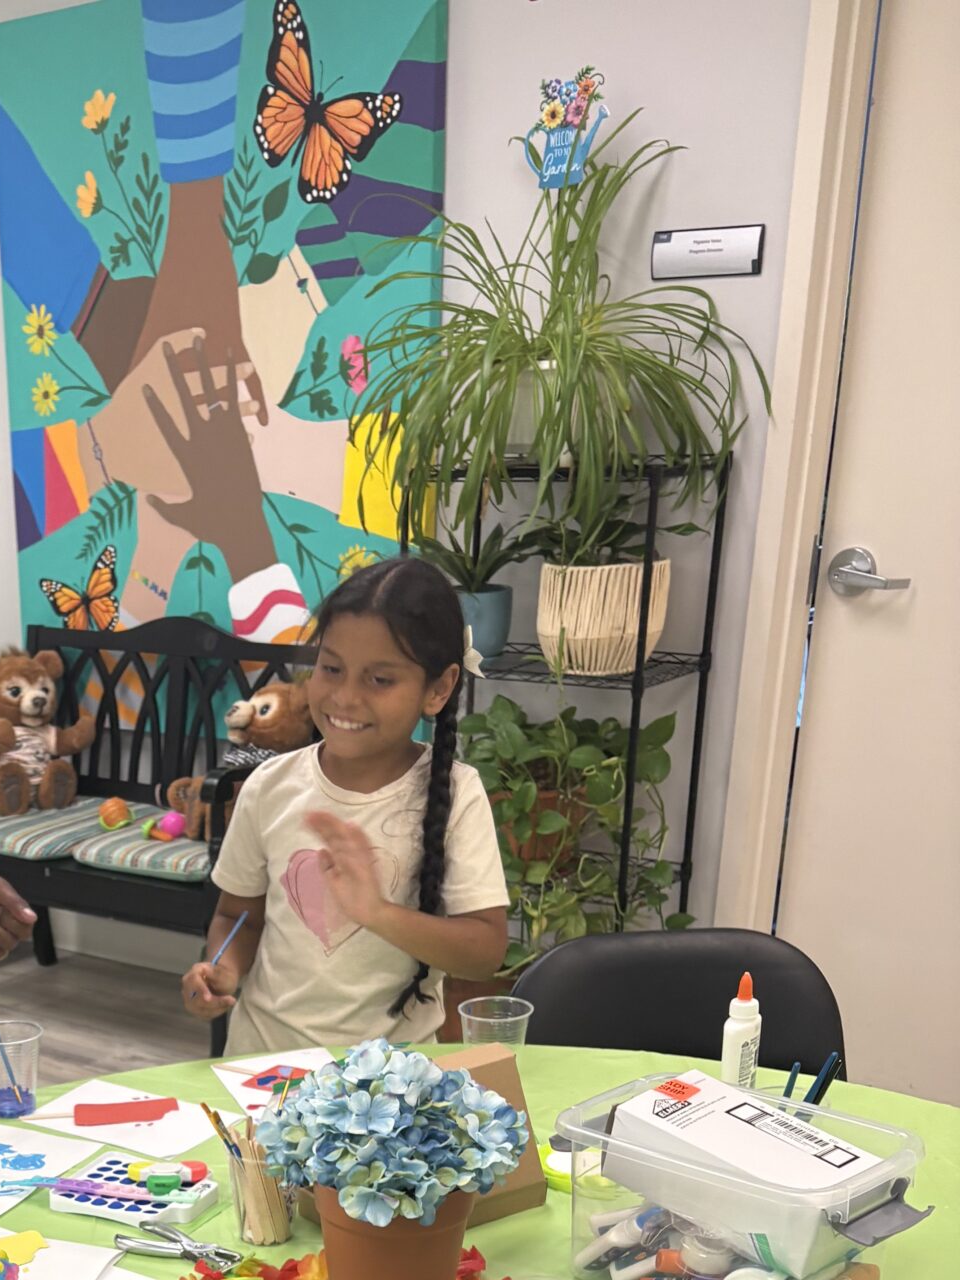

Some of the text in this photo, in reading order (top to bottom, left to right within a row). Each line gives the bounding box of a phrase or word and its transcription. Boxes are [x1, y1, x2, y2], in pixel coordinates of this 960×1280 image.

[550, 130, 574, 147] WELCOM
[554, 148, 564, 157] TO
[543, 153, 581, 182] Gardn
